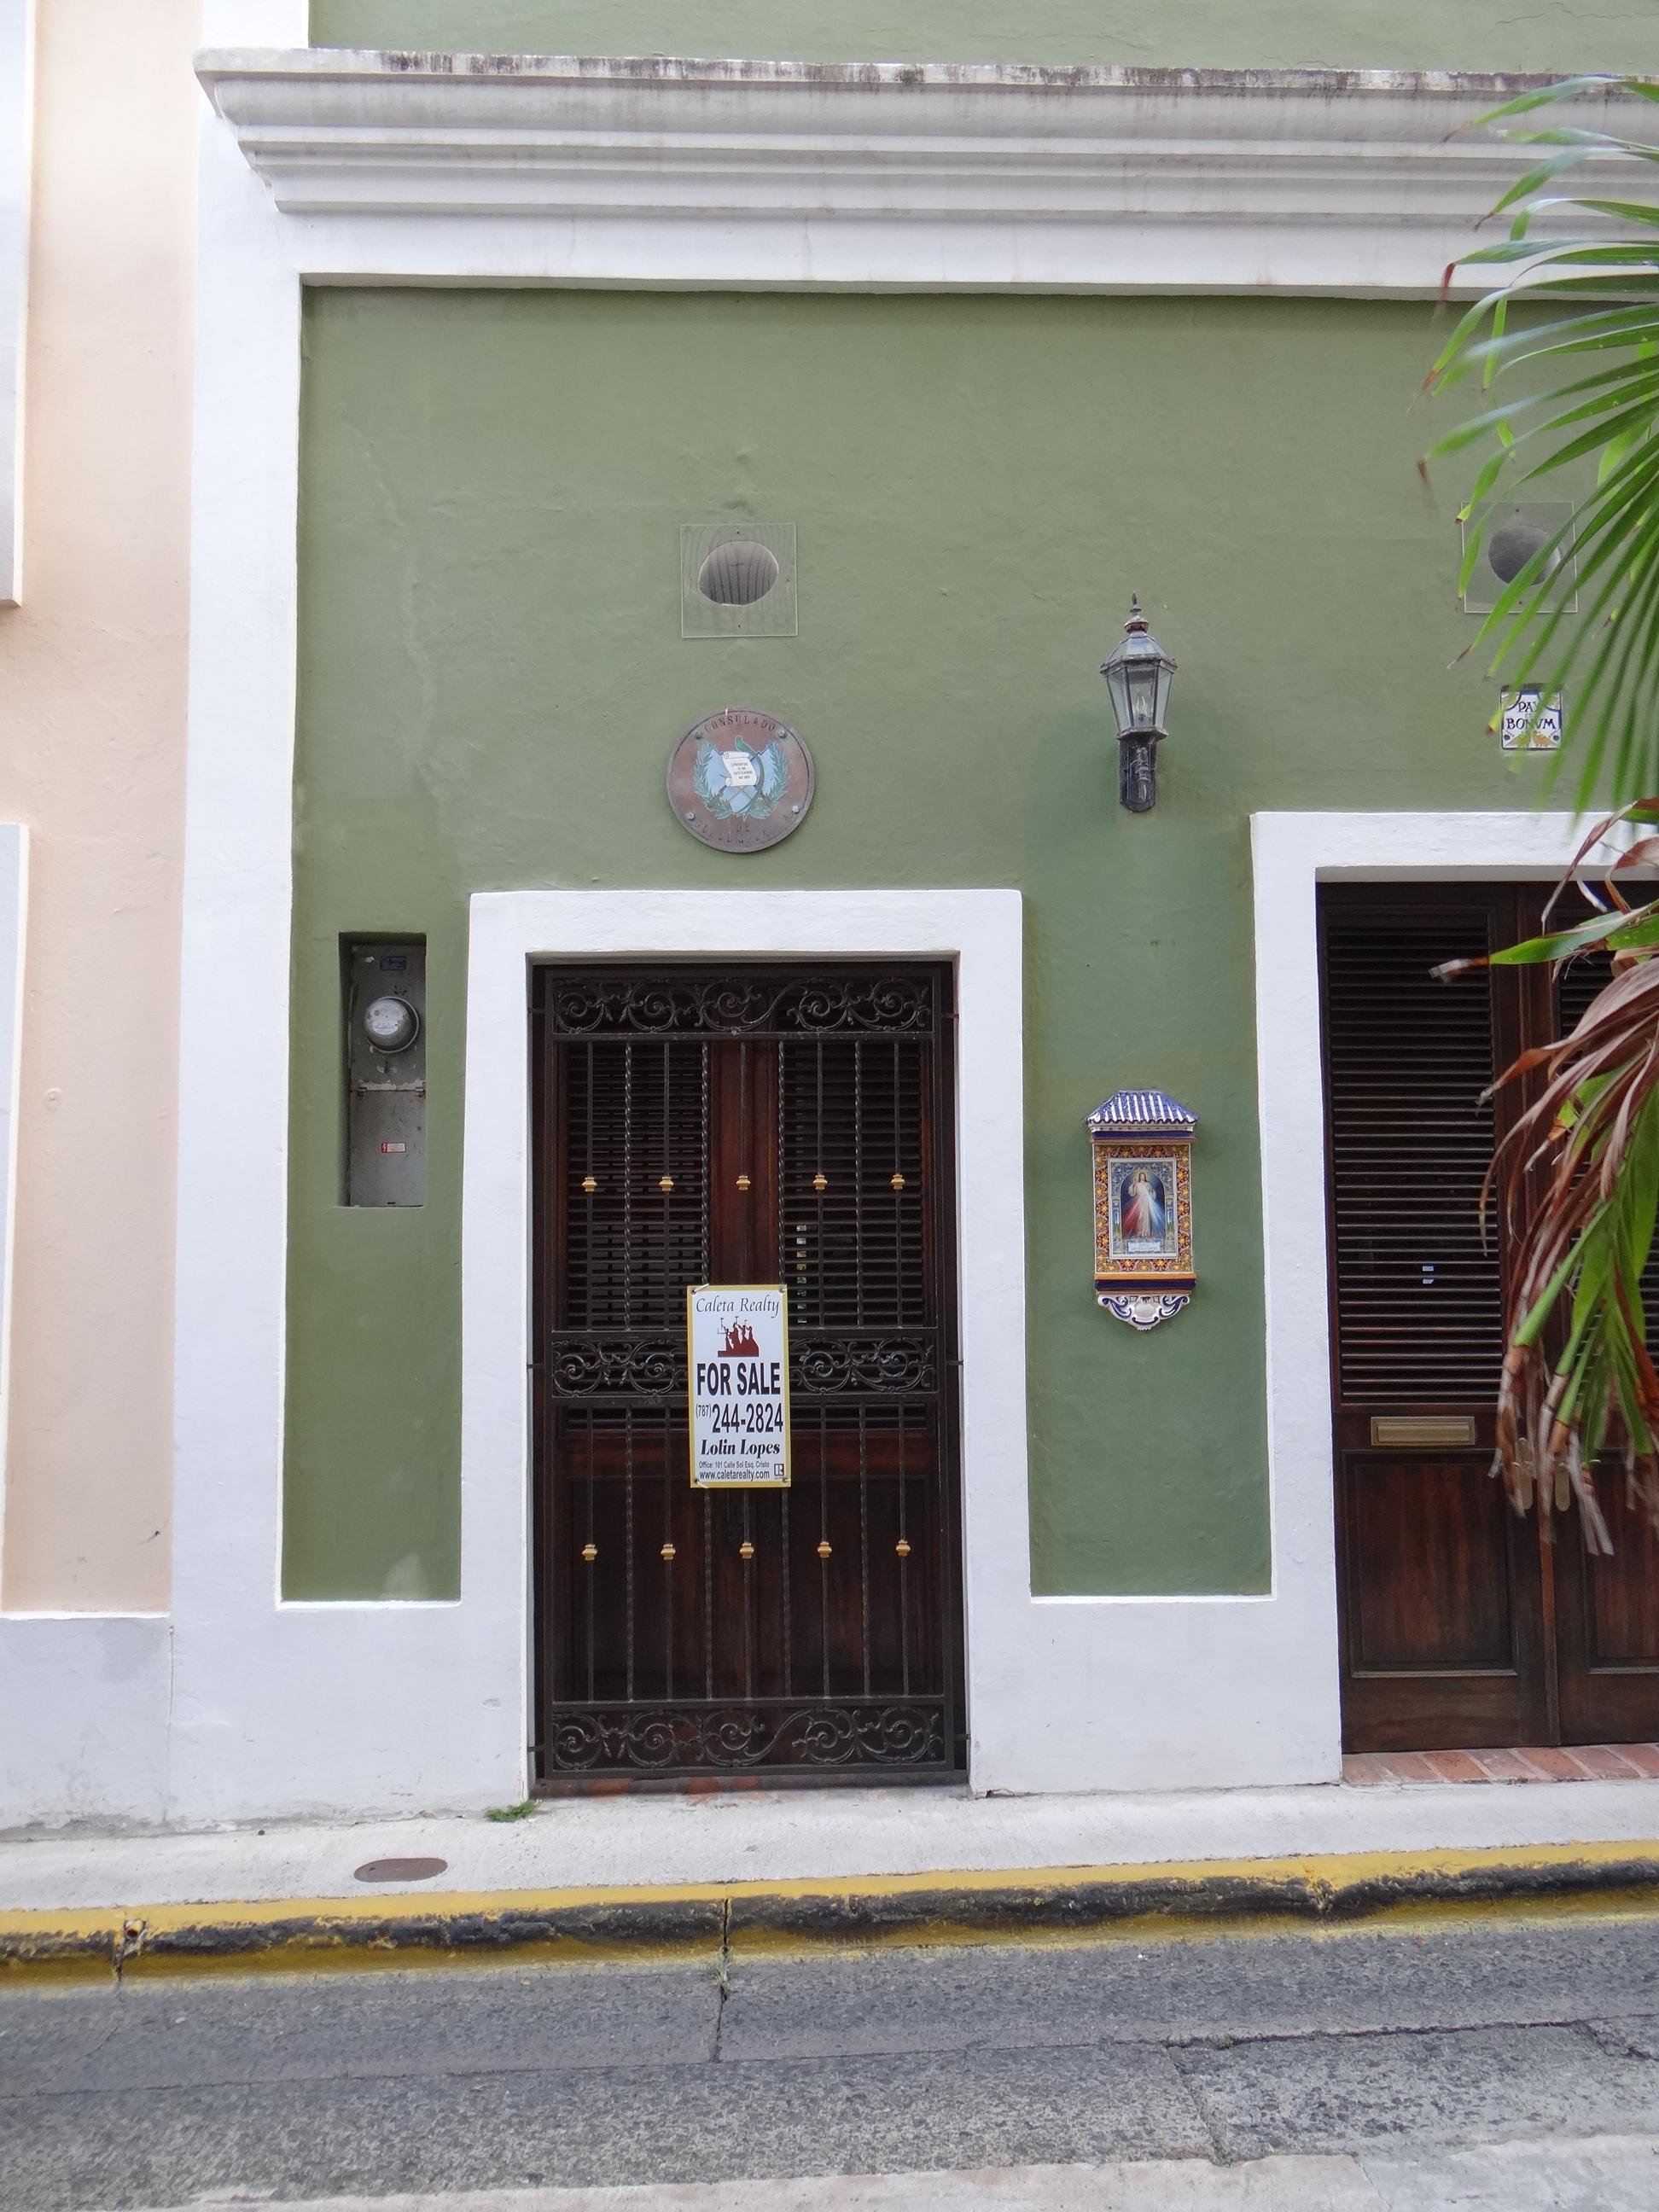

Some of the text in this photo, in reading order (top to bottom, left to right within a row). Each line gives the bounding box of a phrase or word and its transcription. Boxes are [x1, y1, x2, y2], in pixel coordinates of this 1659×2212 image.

[704, 715, 775, 731] CONSULADO
[696, 1295, 780, 1318] Caleta Realty
[696, 1363, 781, 1396] FOR SALE
[696, 1403, 783, 1433] (787) 244-2824
[701, 1440, 780, 1458] Lolin Lopes
[700, 1470, 770, 1481] www.caletarealty.com
